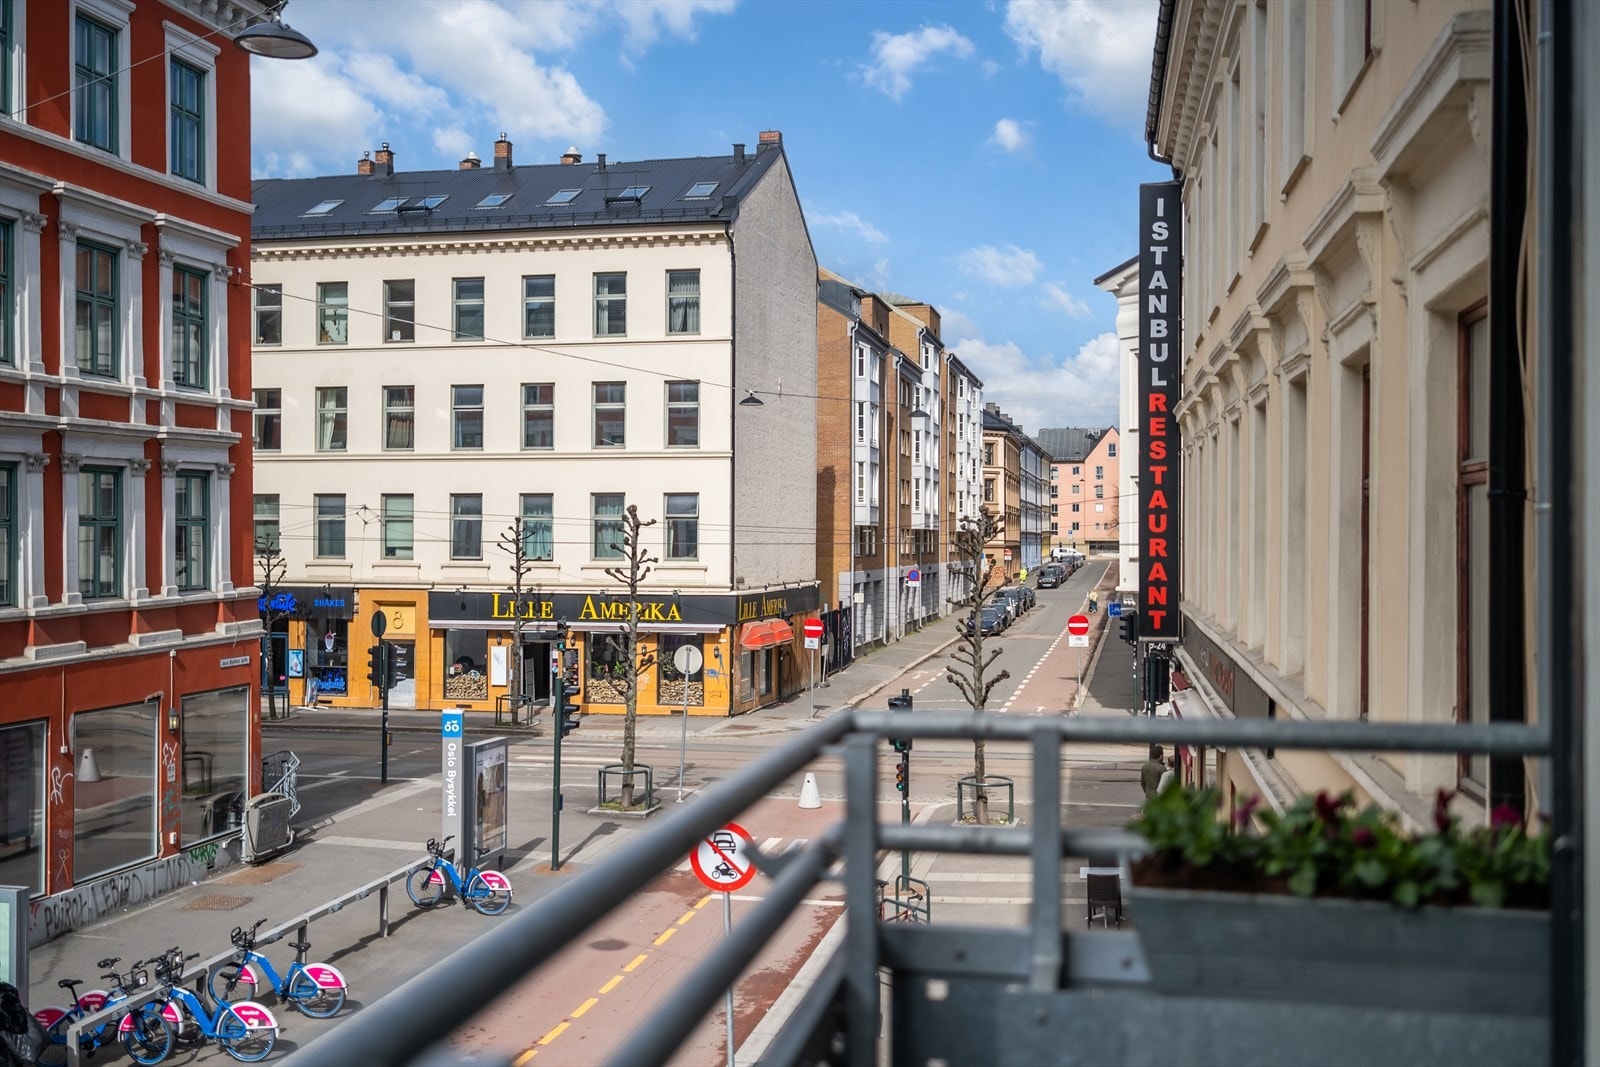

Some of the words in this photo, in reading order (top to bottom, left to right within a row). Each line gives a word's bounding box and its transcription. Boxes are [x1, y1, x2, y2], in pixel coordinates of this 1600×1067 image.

[1148, 197, 1169, 387] ISTANBUL
[1147, 393, 1168, 630] RESTAURANT
[313, 599, 345, 608] SHAKES
[392, 609, 404, 630] 8
[447, 743, 457, 767] Oslo
[445, 770, 457, 817] Bysykkel
